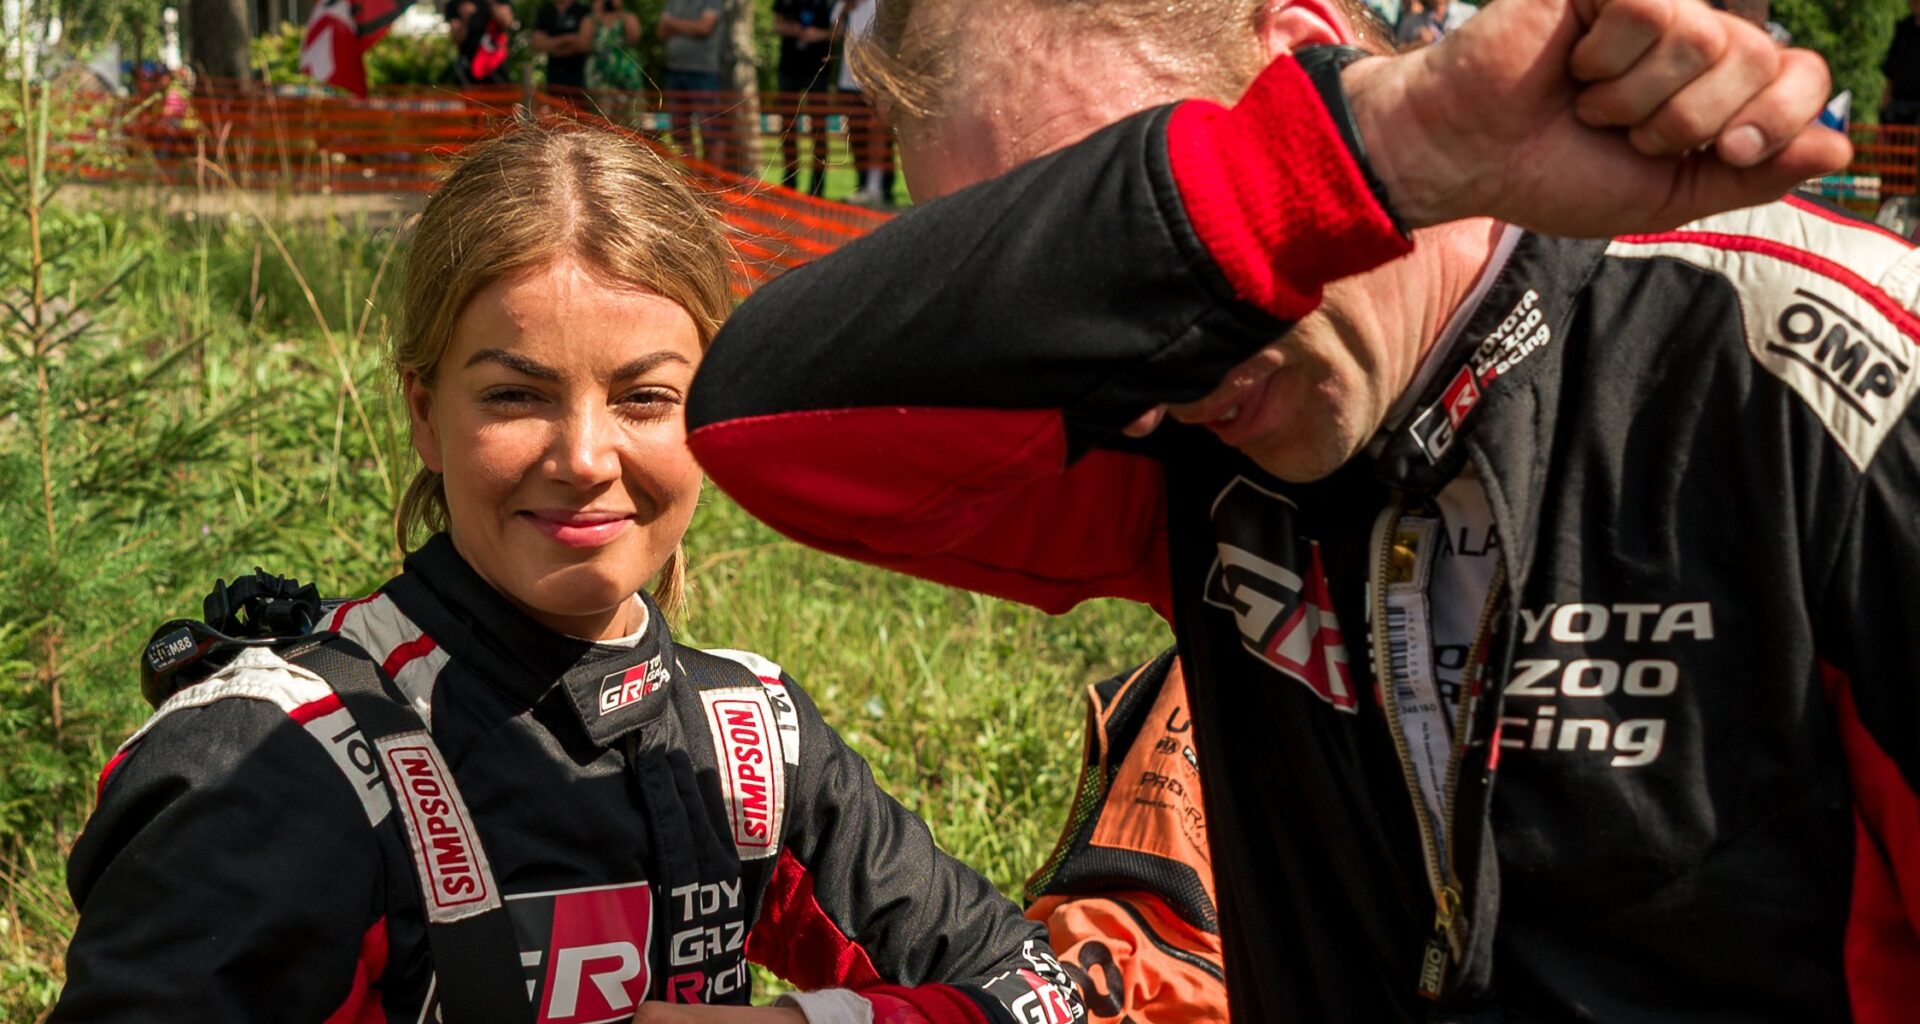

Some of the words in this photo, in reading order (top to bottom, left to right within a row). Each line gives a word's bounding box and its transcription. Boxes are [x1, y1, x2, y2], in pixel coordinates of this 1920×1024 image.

[1470, 289, 1539, 364] TOYOTA
[1476, 308, 1543, 377] GAZOO
[1479, 323, 1551, 388] Racing
[1778, 303, 1897, 398] OMP
[1426, 381, 1478, 459] GR
[1520, 602, 1714, 644] YOTA
[601, 678, 643, 711] GR
[1502, 659, 1679, 697] ZOO
[1499, 705, 1667, 767] cing
[725, 708, 767, 839] SIMPSON
[401, 758, 476, 896] SIMPSON
[671, 876, 742, 921] TOY
[670, 920, 745, 966] GAZ
[1426, 947, 1442, 993] OMP
